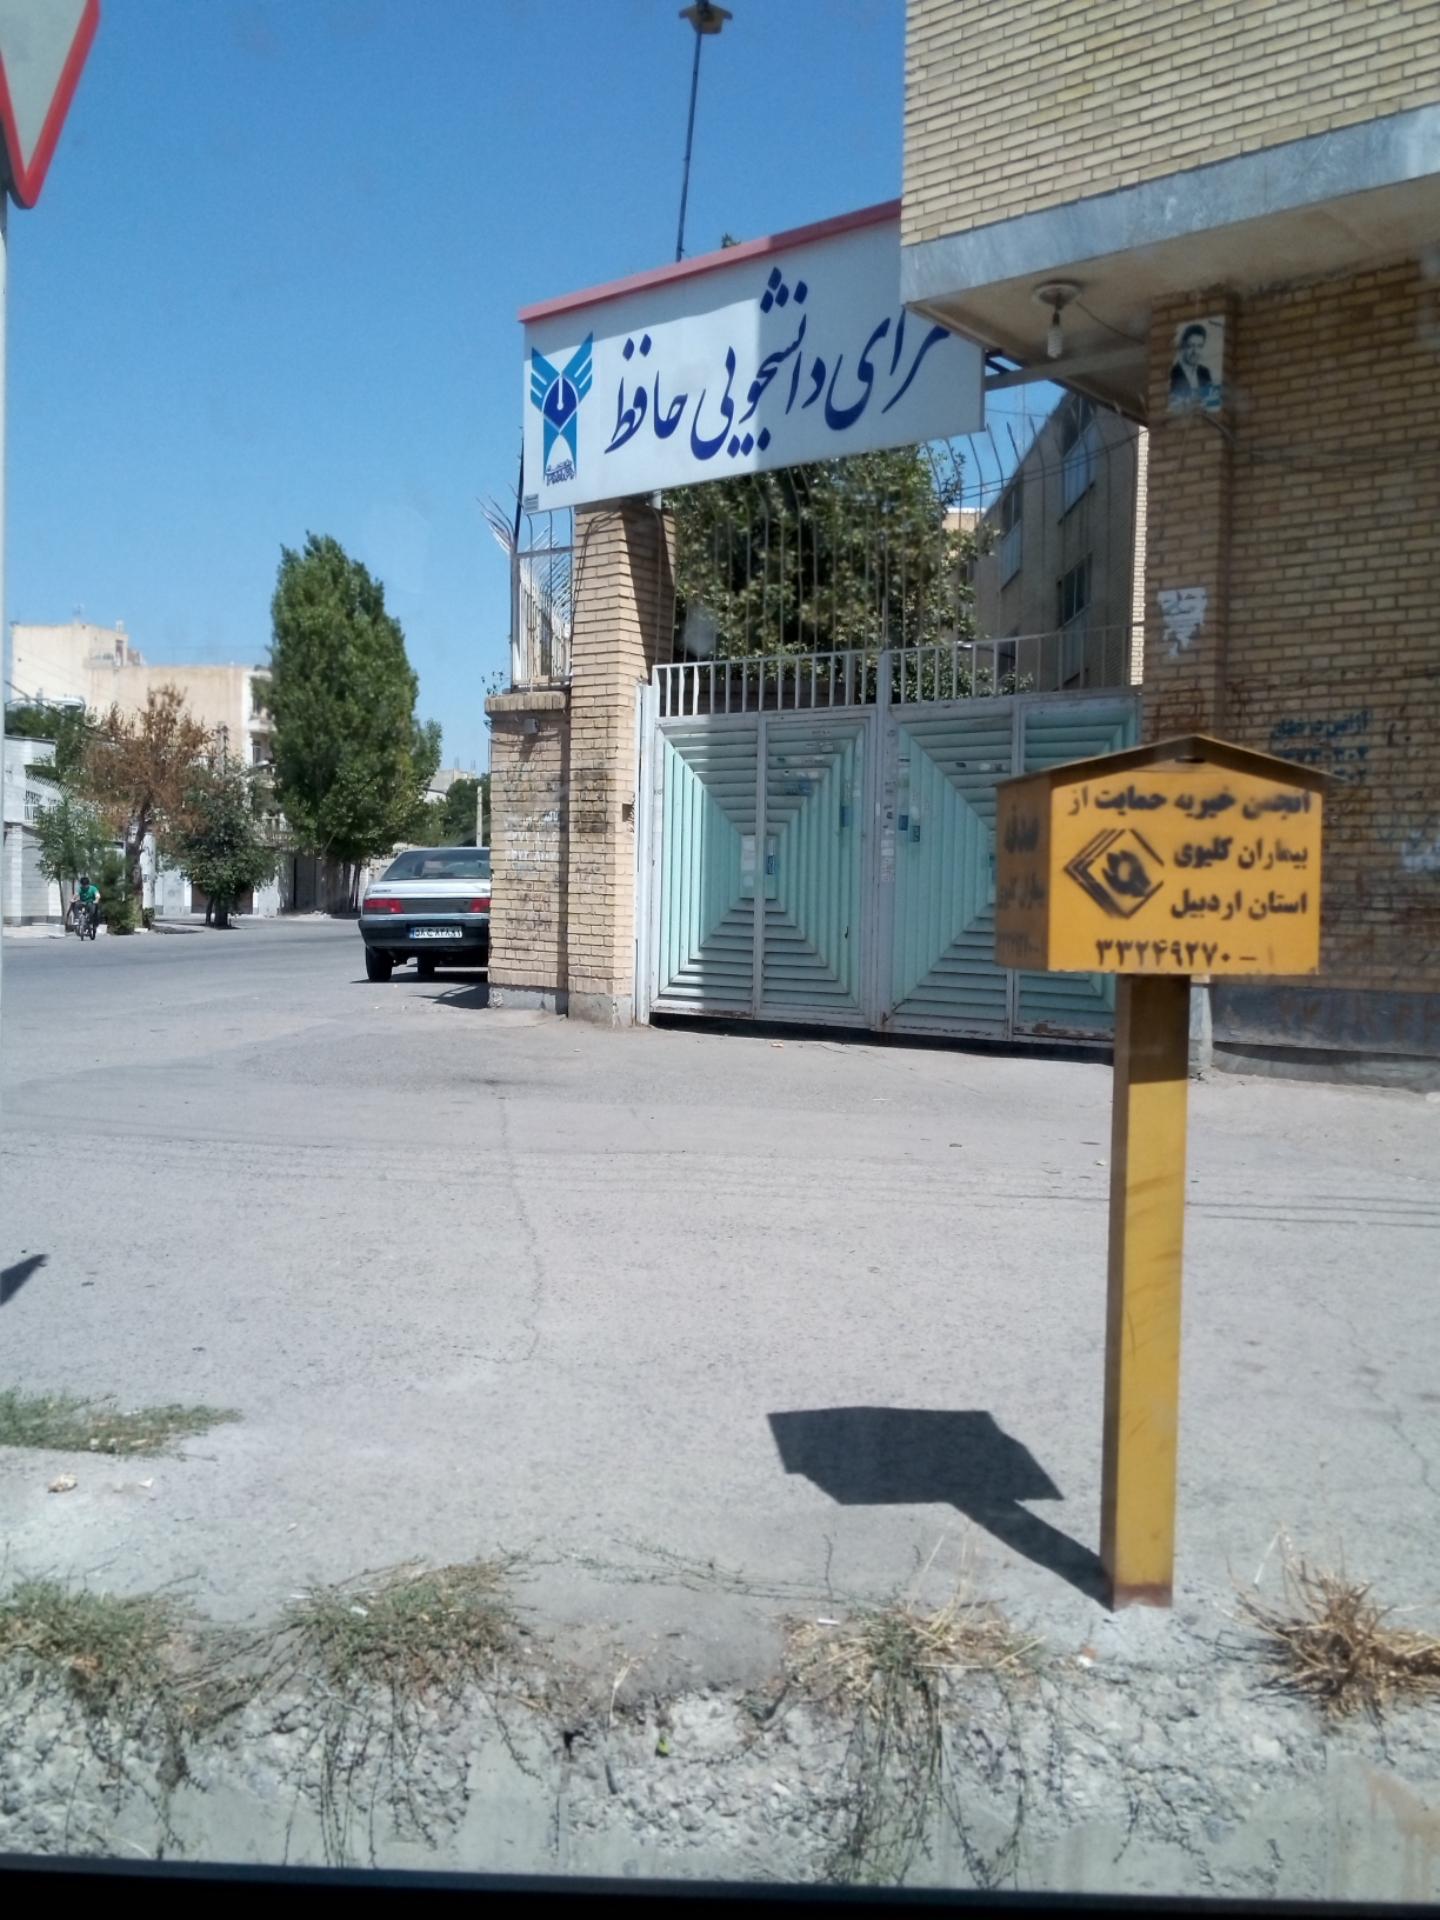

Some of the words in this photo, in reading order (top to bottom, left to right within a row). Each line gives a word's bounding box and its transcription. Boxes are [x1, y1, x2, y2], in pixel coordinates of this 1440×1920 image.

[825, 303, 951, 430] رای
[604, 333, 688, 454] حافظ
[1067, 784, 1088, 816] از
[1094, 784, 1168, 816] حمایت
[1174, 785, 1236, 820] خیریه
[1243, 788, 1311, 820] انجمن
[1173, 836, 1234, 869] کلیوی
[1237, 838, 1308, 870] بیماران
[1169, 888, 1242, 920] اردبیل
[1247, 890, 1307, 921] استان
